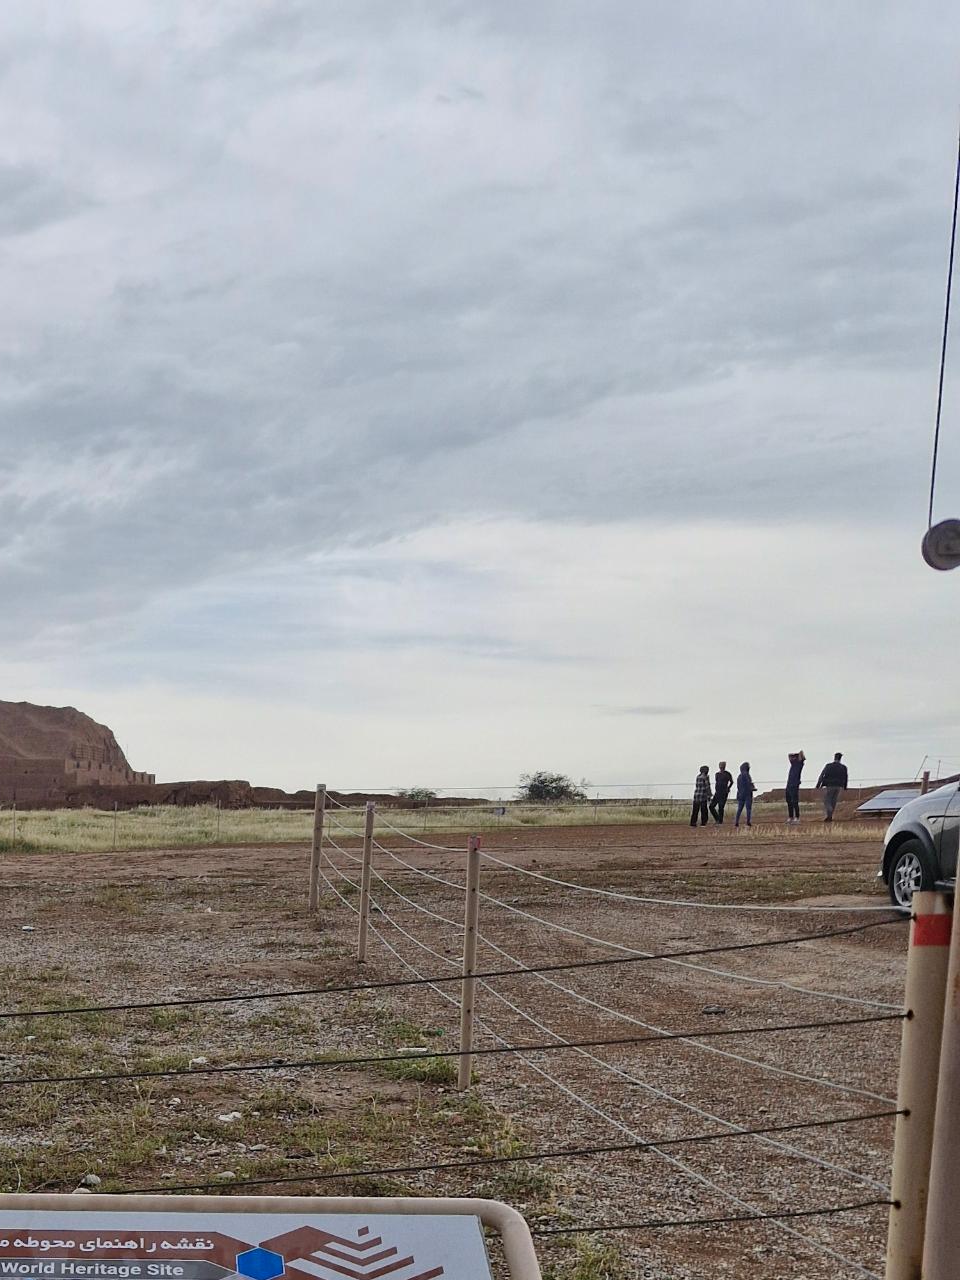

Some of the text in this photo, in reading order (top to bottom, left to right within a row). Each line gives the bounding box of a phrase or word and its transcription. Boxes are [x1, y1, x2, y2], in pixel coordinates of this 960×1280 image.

[13, 1236, 76, 1252] محوطه
[78, 1237, 157, 1253] راهنمای
[160, 1237, 215, 1250] نقشه
[1, 1261, 55, 1274] World
[60, 1262, 142, 1277] Heritage
[147, 1263, 185, 1277] Site
